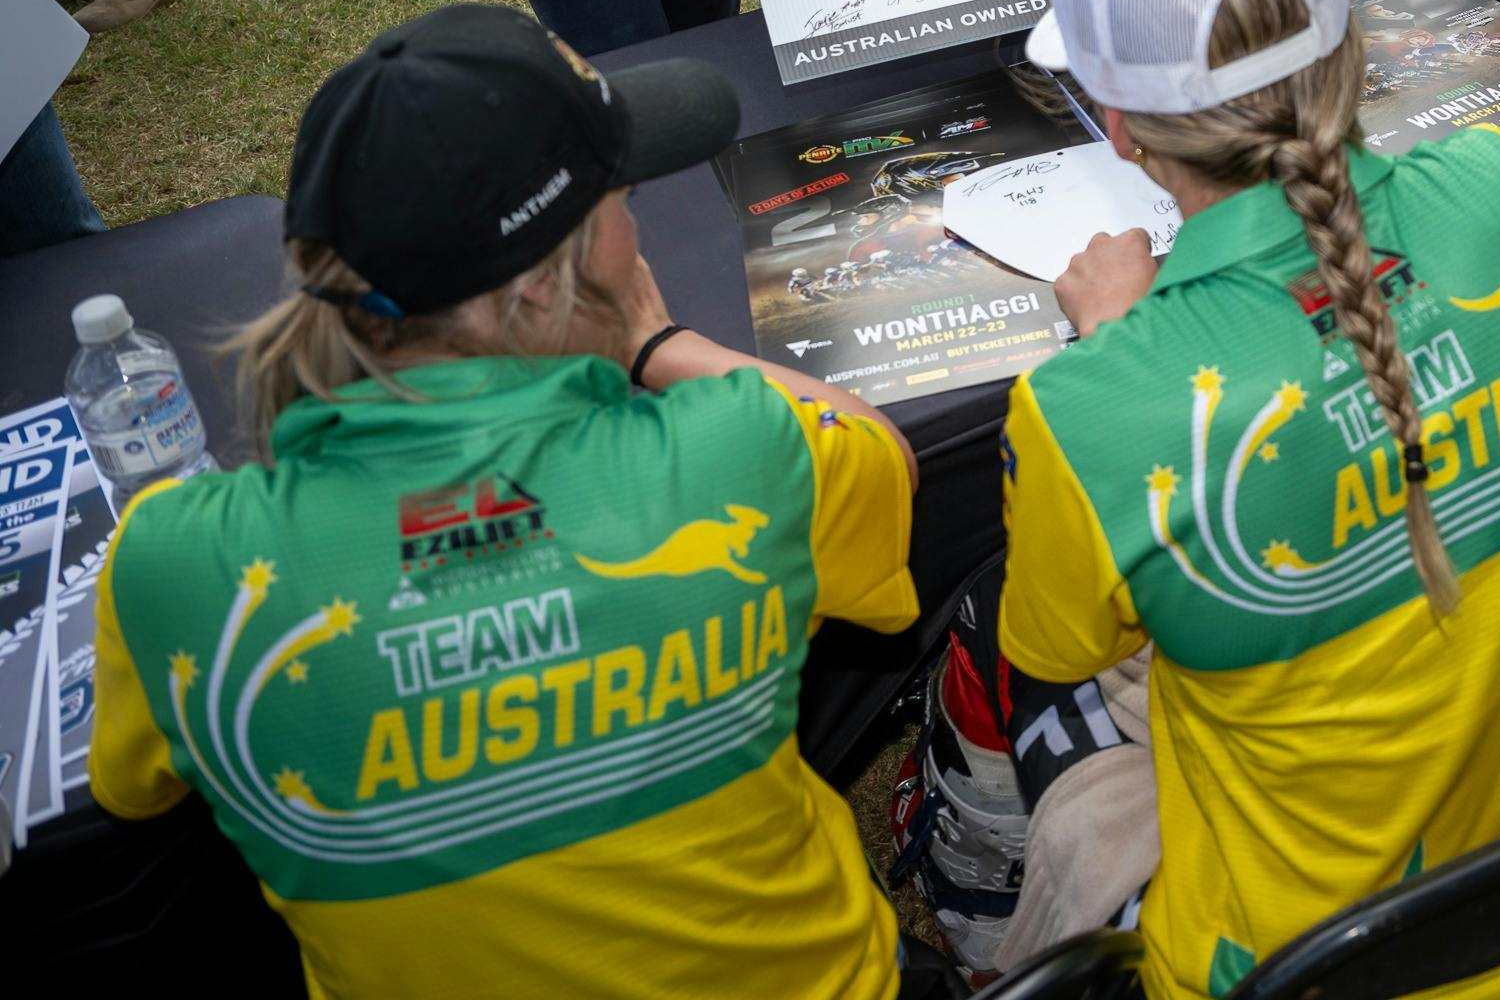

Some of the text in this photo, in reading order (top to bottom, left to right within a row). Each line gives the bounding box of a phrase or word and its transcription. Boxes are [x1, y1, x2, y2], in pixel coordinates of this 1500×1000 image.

[793, 17, 954, 67] AUSTRALIAN
[1436, 84, 1475, 101] ROUND
[1451, 106, 1494, 128] MARCH
[798, 147, 843, 162] PENRITE
[500, 167, 573, 236] ANTHEM
[762, 192, 790, 210] DAYS
[791, 187, 805, 199] OF
[805, 175, 845, 195] ACTION
[853, 293, 1041, 347] WONTHAGGI
[911, 295, 964, 315] ROUND
[824, 352, 940, 386] AUSPROMX.COM.AU
[947, 345, 972, 360] BUY
[972, 335, 1021, 353] TICKETS
[1020, 328, 1052, 344] HERE
[896, 320, 1007, 351] MARCH 22-23
[401, 507, 547, 561] EZILIFT
[377, 588, 581, 697] TEAM
[355, 585, 788, 800] AUSTRALIA
